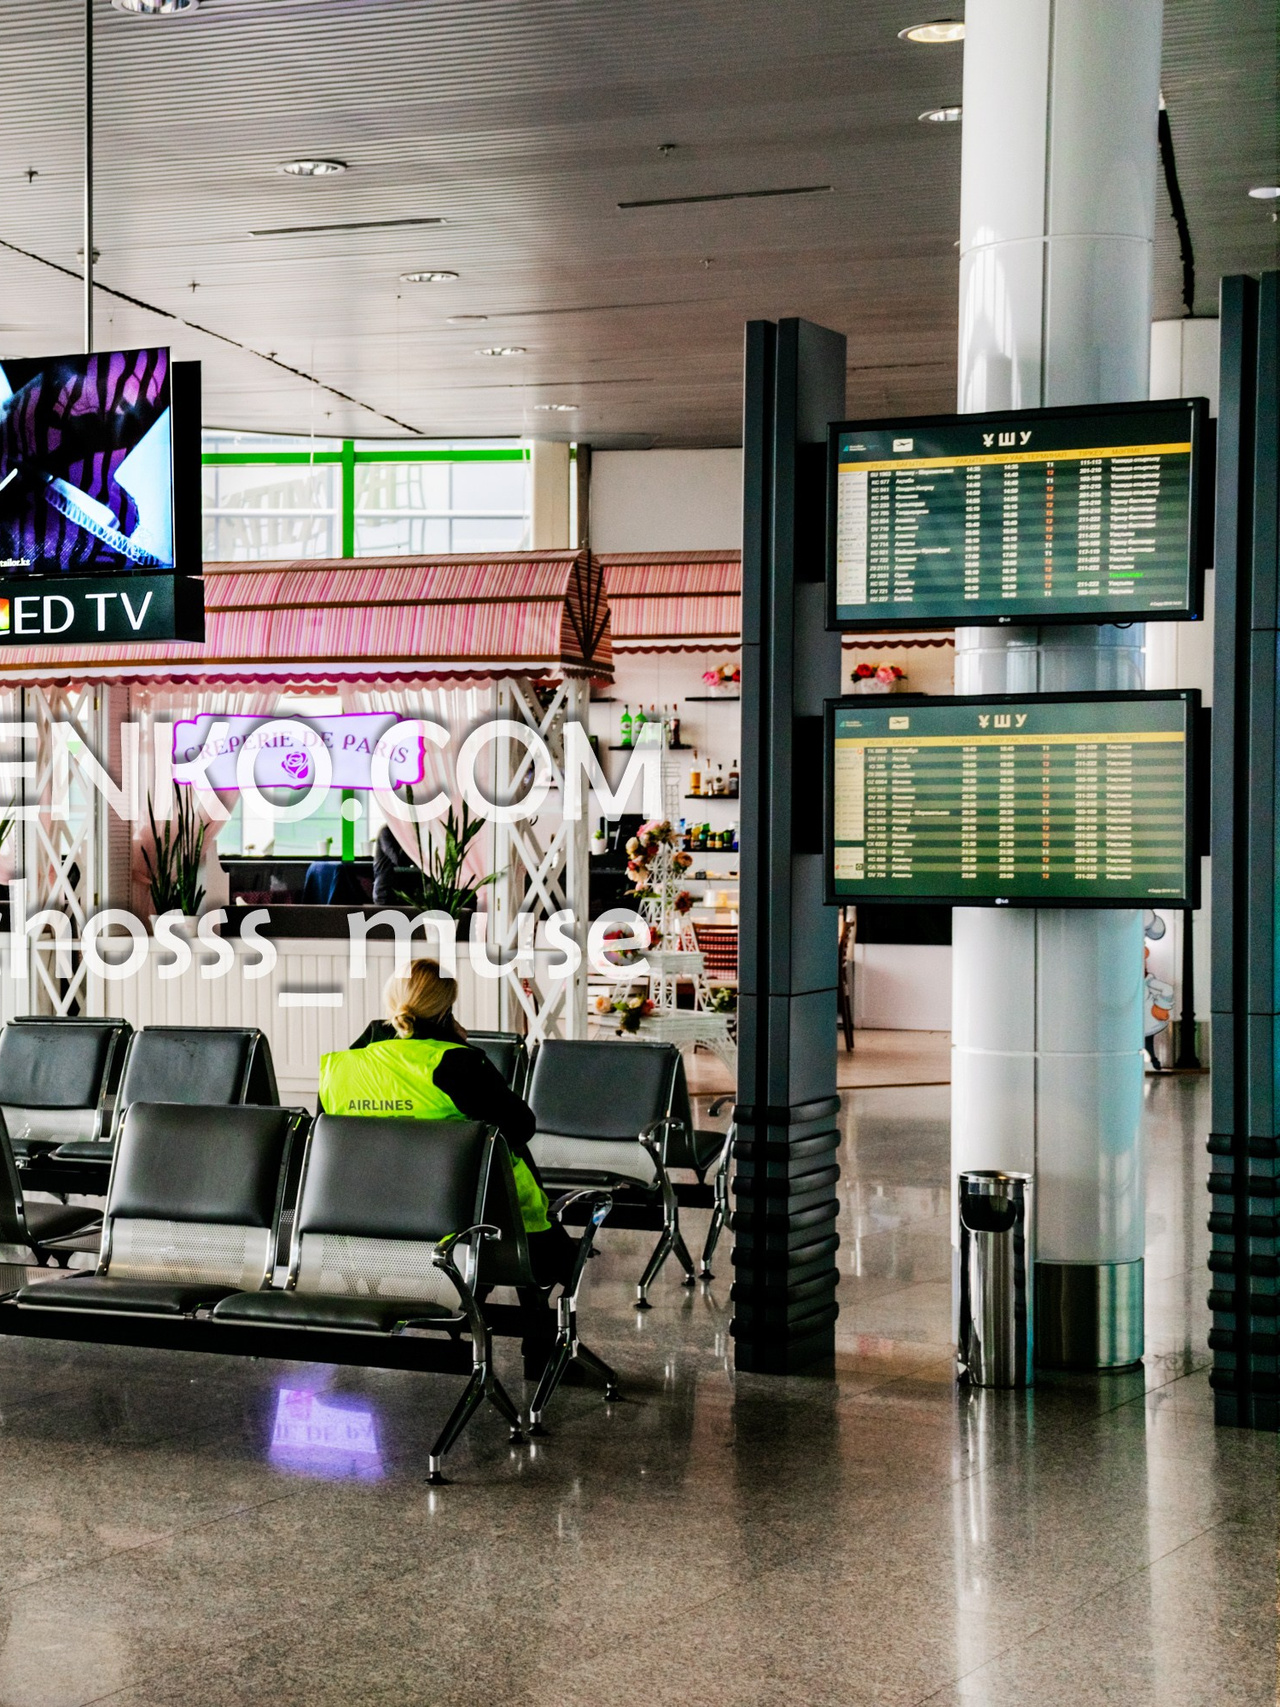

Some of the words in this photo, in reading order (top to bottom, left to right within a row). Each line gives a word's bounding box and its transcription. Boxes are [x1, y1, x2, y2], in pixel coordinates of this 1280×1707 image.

[85, 591, 153, 631] TV
[302, 731, 334, 748] DE
[342, 734, 409, 764] PARIS
[348, 1099, 413, 1111] AIRLINES
